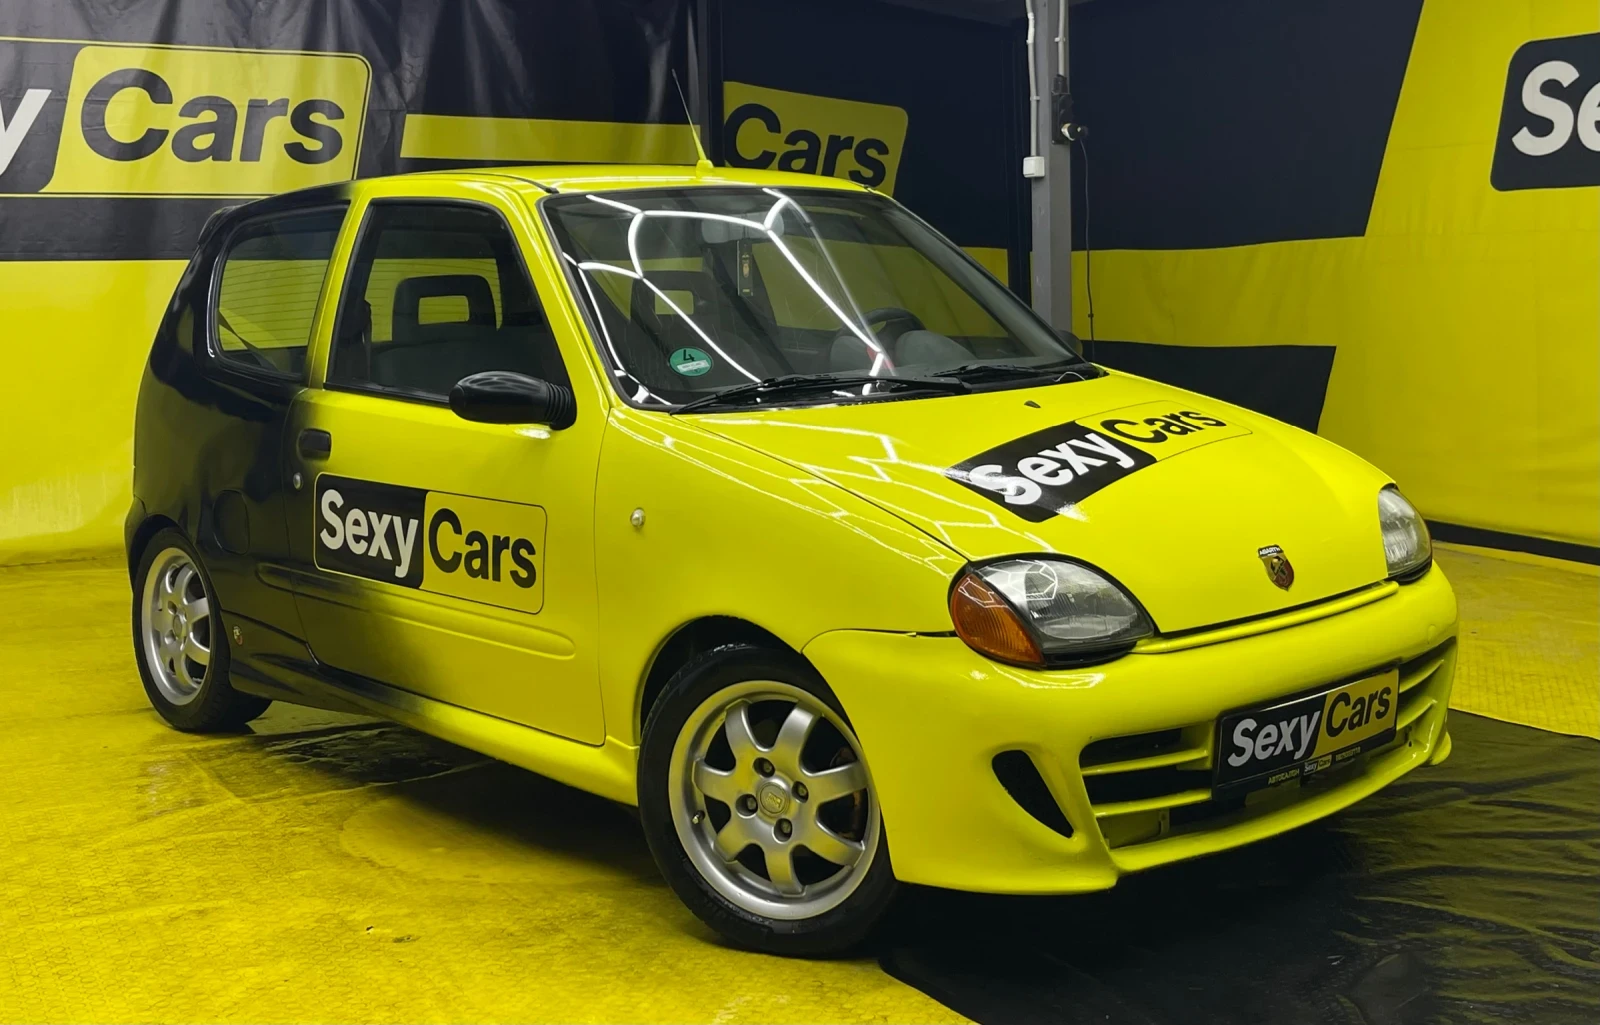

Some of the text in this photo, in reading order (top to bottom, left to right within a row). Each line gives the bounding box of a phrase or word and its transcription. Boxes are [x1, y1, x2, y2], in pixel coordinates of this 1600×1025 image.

[81, 67, 345, 165] Cars
[724, 102, 890, 188] Cars
[682, 349, 695, 361] 4
[968, 410, 1227, 506] Sexy Cars
[320, 488, 536, 589] Sexy Cars
[1227, 686, 1391, 767] Sexy Cars
